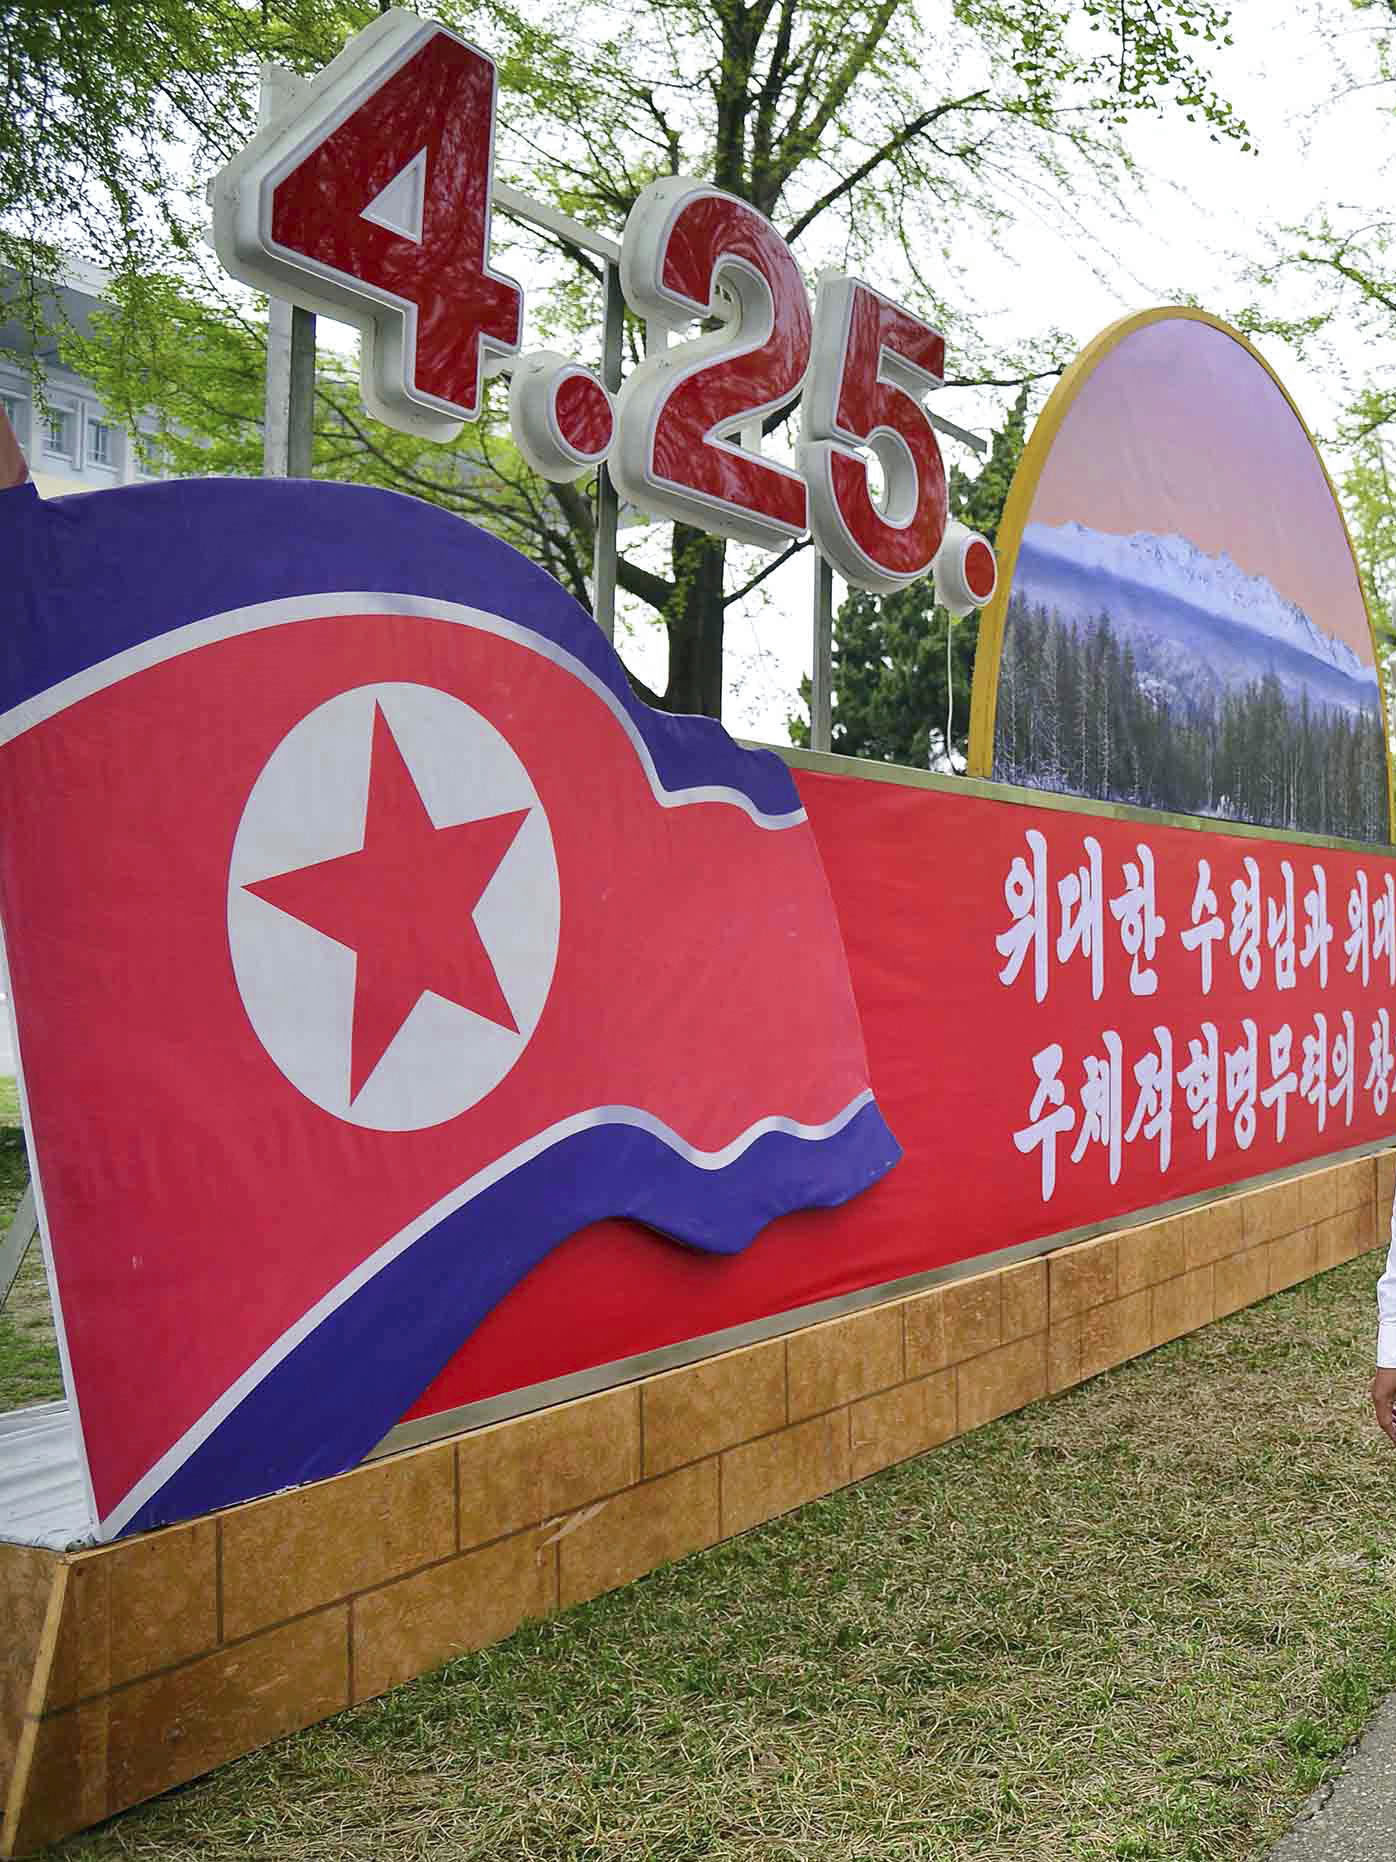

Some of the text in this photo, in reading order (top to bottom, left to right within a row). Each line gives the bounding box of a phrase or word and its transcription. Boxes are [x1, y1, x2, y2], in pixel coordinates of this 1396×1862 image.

[256, 16, 998, 610] 4.25.
[994, 828, 1167, 1004] 위대한
[1179, 855, 1335, 997] 수령님과
